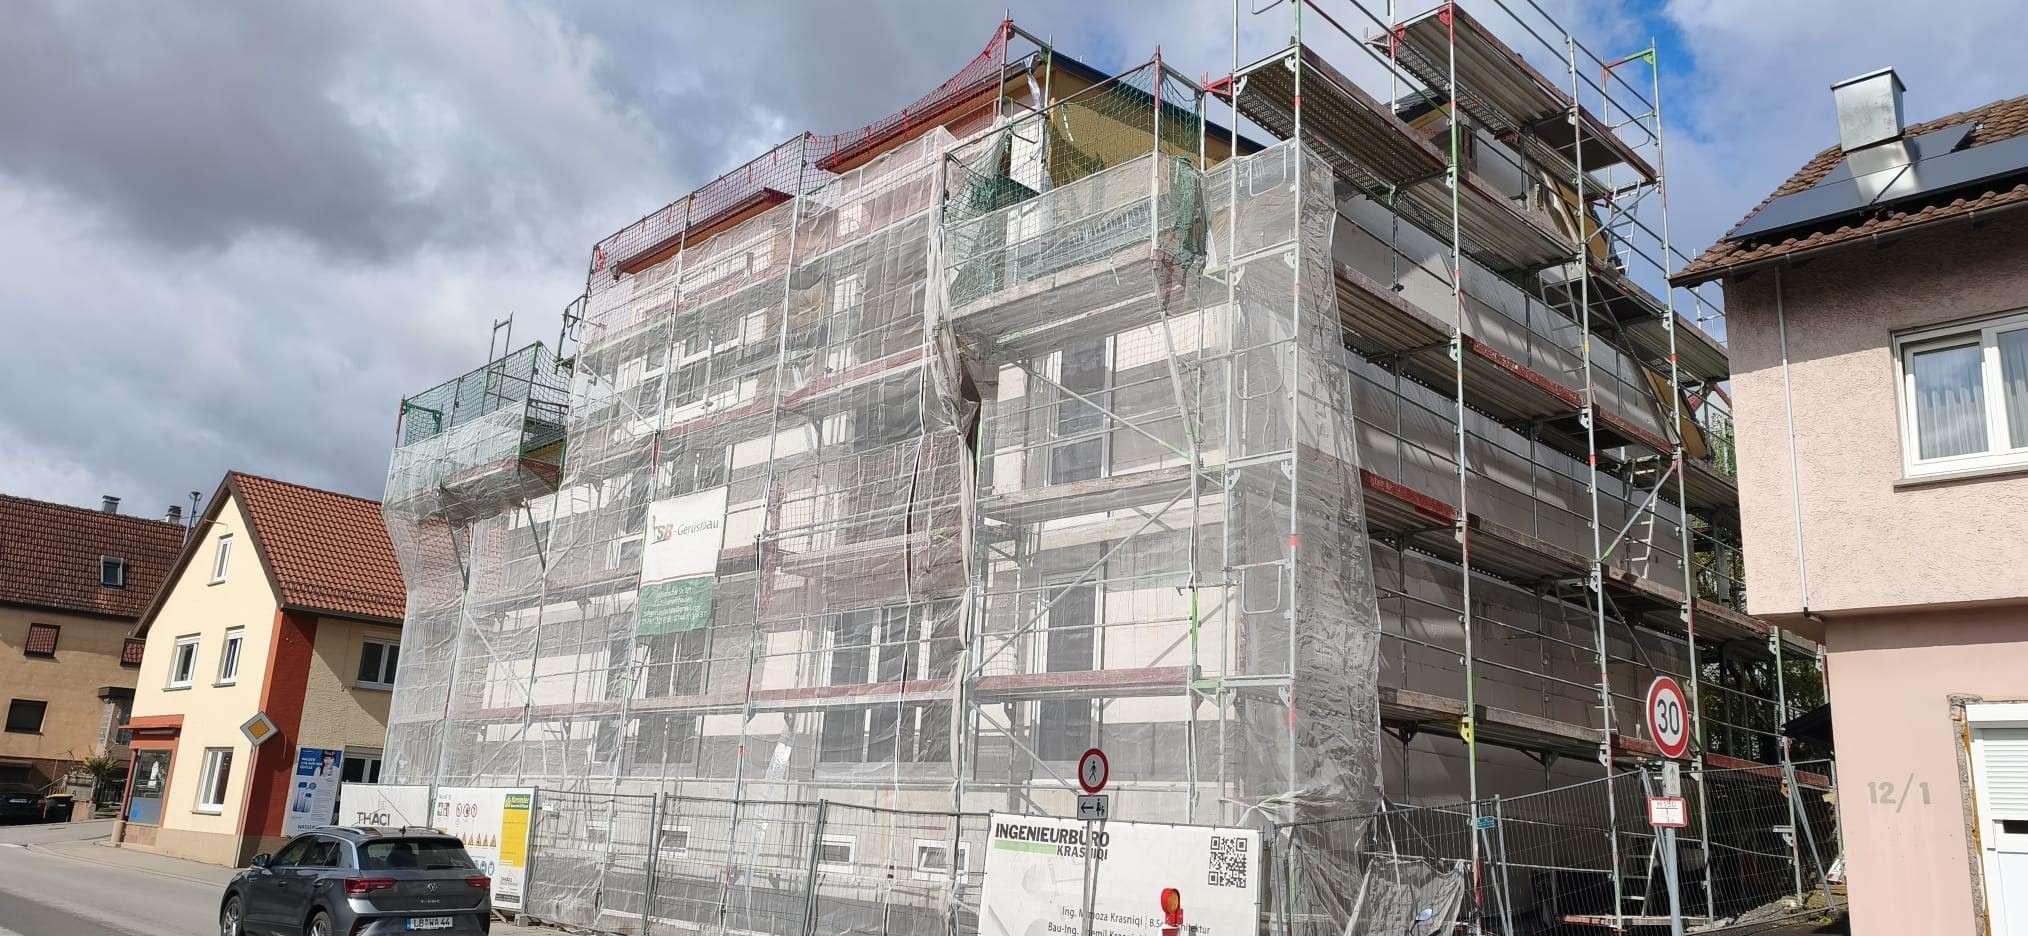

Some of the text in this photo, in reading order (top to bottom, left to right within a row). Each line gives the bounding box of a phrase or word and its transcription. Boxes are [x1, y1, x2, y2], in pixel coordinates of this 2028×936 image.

[1656, 699, 1680, 736] 30
[1867, 772, 1931, 813] 12/1
[994, 823, 1110, 847] INGENIEURBÜRO
[1048, 921, 1080, 936] Bau-Ing.
[1062, 906, 1077, 919] Ing.
[1110, 912, 1142, 928] Krasniqi
